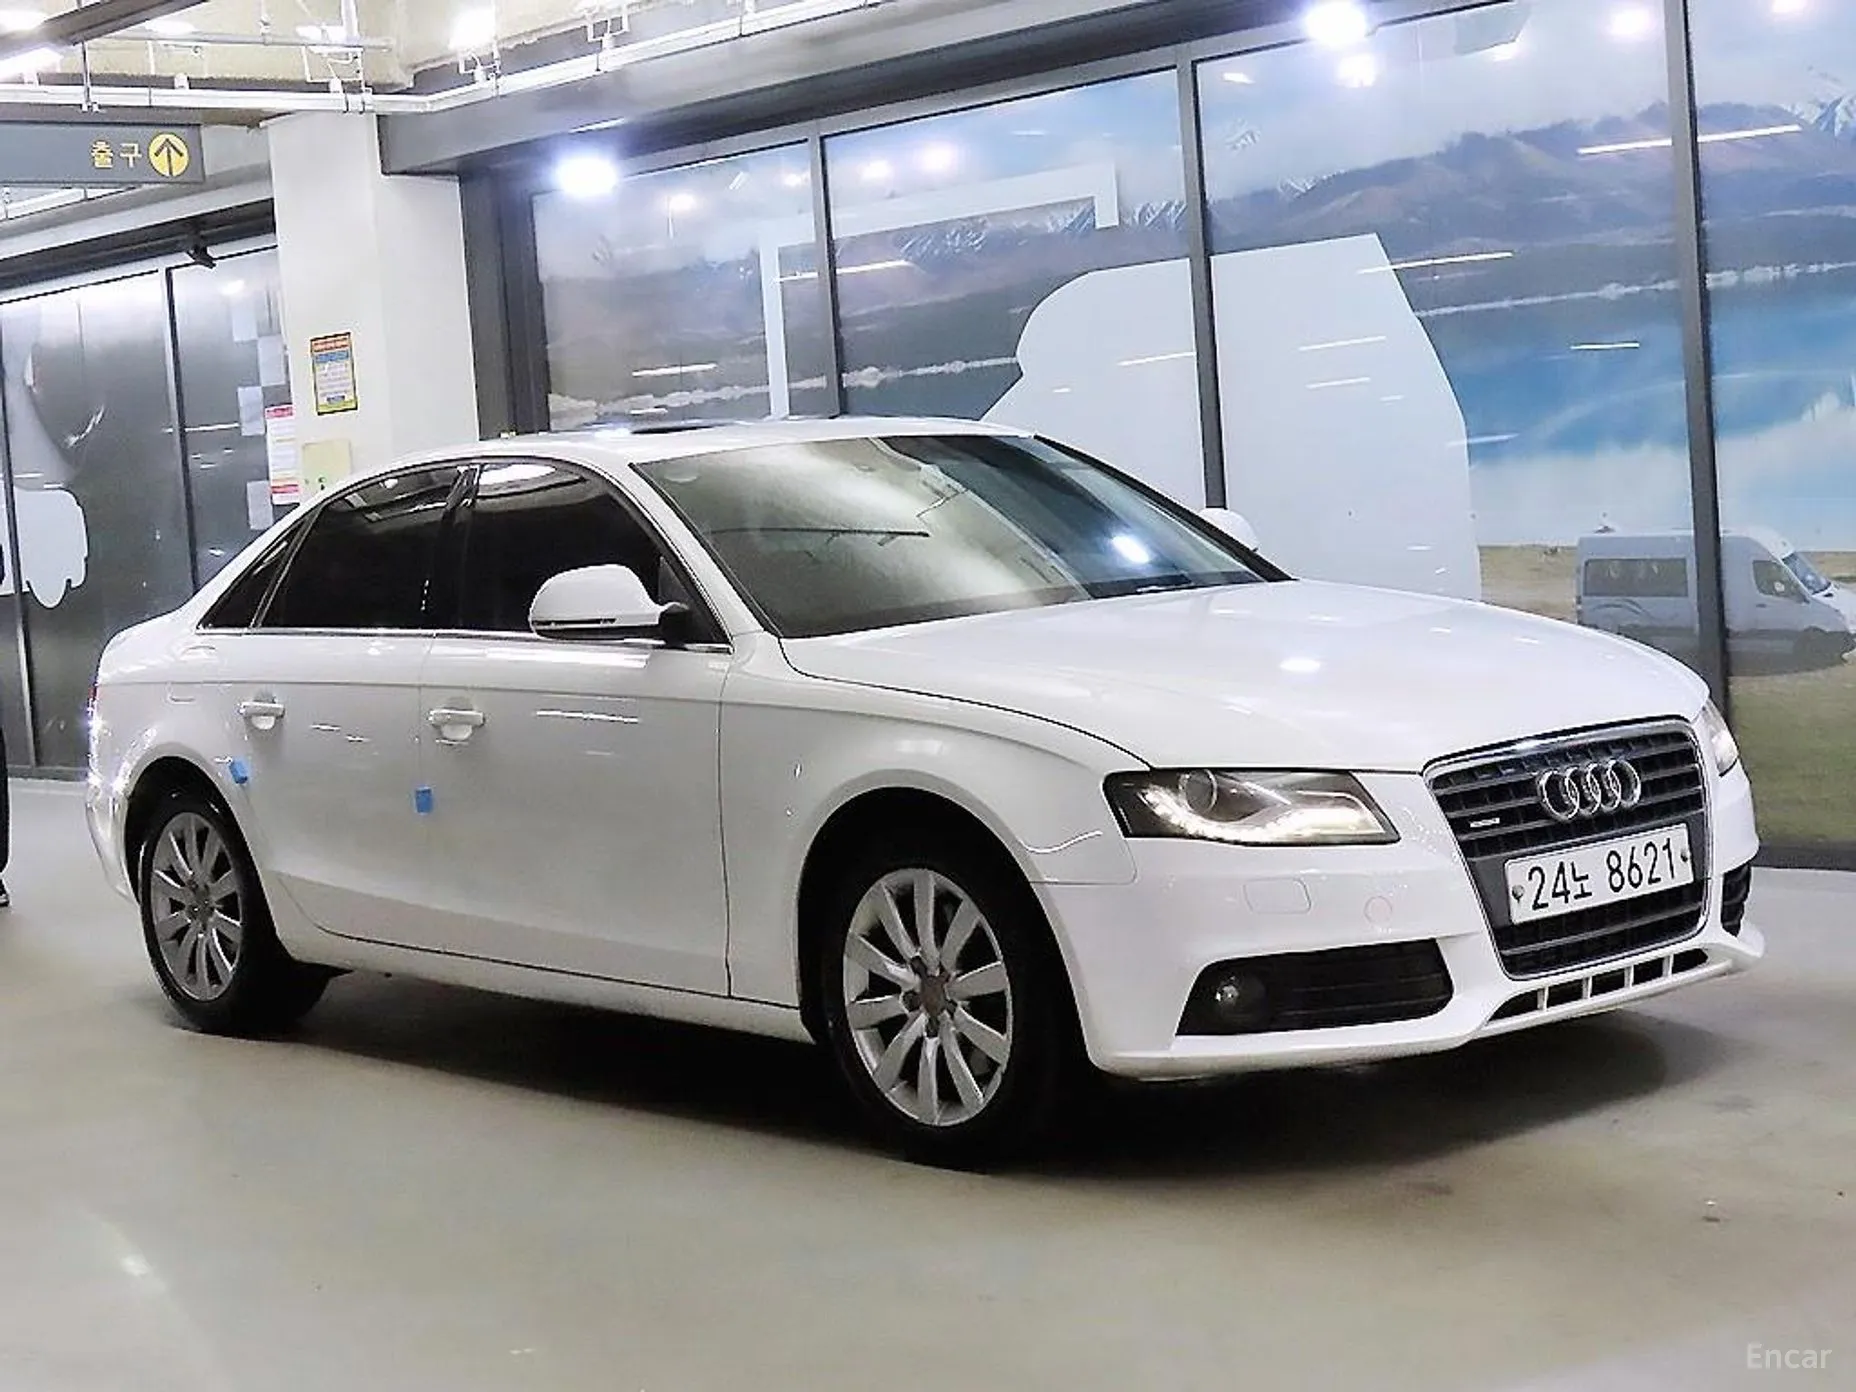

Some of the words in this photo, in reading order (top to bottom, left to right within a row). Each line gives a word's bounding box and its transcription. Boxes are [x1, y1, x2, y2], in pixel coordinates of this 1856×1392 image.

[90, 140, 142, 169] 출구
[1528, 861, 1592, 911] 24노
[1606, 837, 1675, 893] 8621
